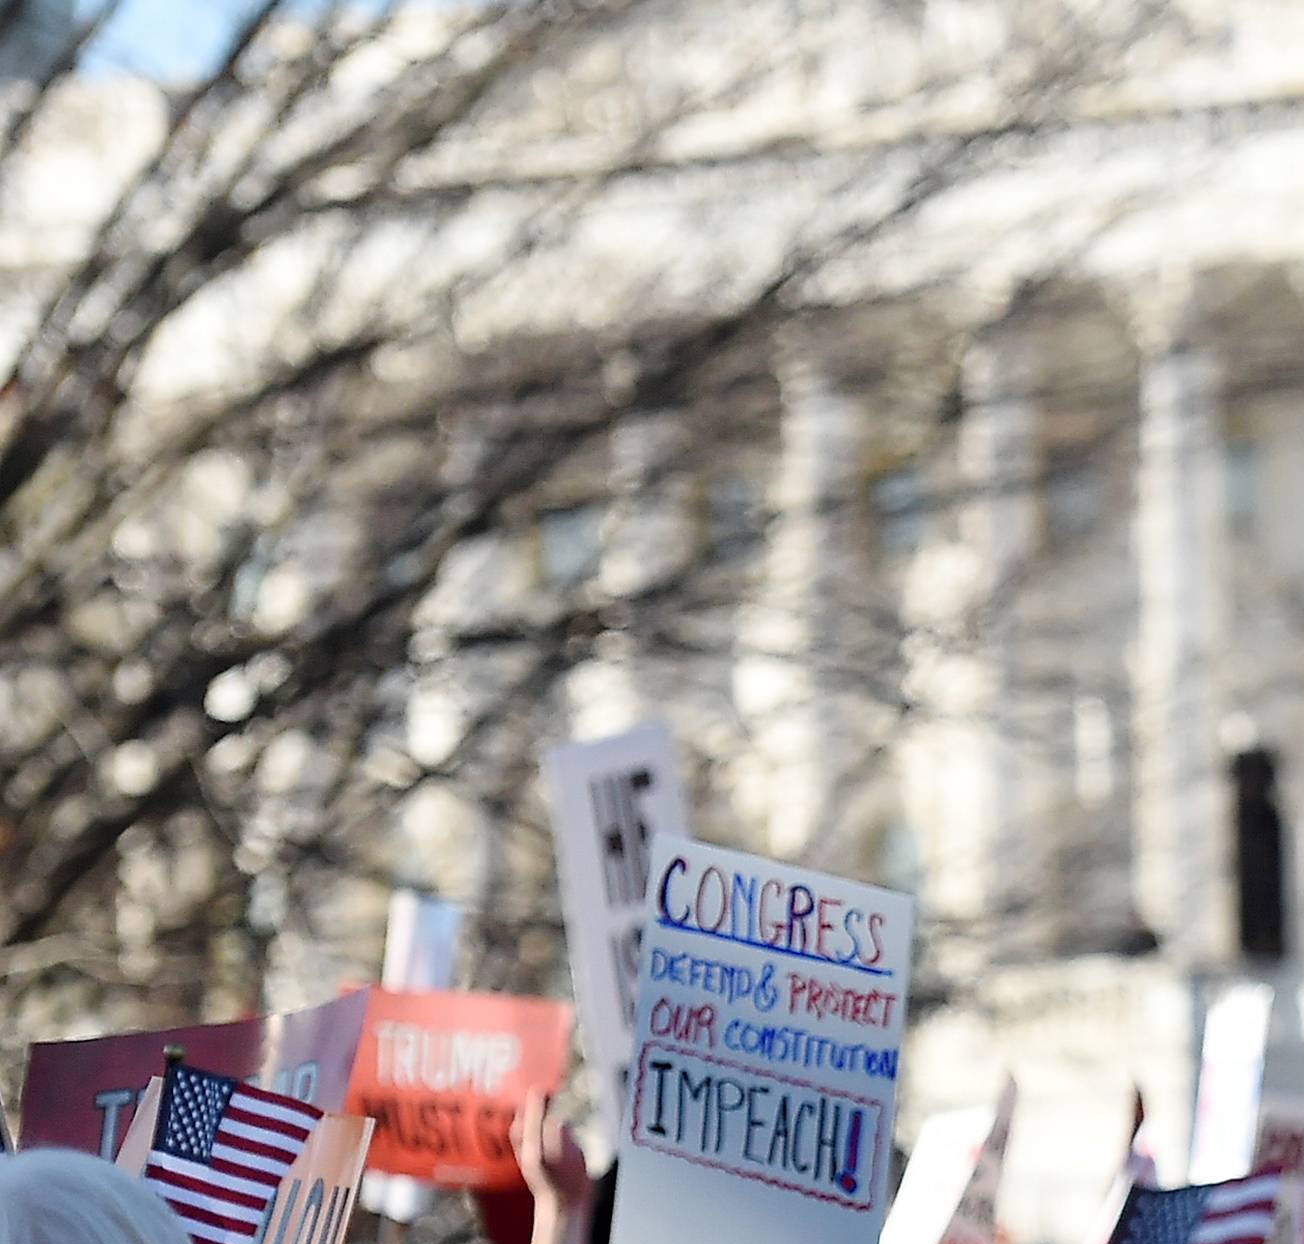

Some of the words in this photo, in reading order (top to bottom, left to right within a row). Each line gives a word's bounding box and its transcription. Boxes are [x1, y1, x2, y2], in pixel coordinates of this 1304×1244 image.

[658, 858, 884, 965] CONGRESS
[650, 947, 752, 999] DEFEND
[786, 972, 896, 1029] PROTECT
[375, 1021, 522, 1096] TRUMP
[650, 999, 718, 1048] OUR
[724, 1018, 899, 1082] CONSTITUTION
[646, 1060, 864, 1195] IMPEACH!
